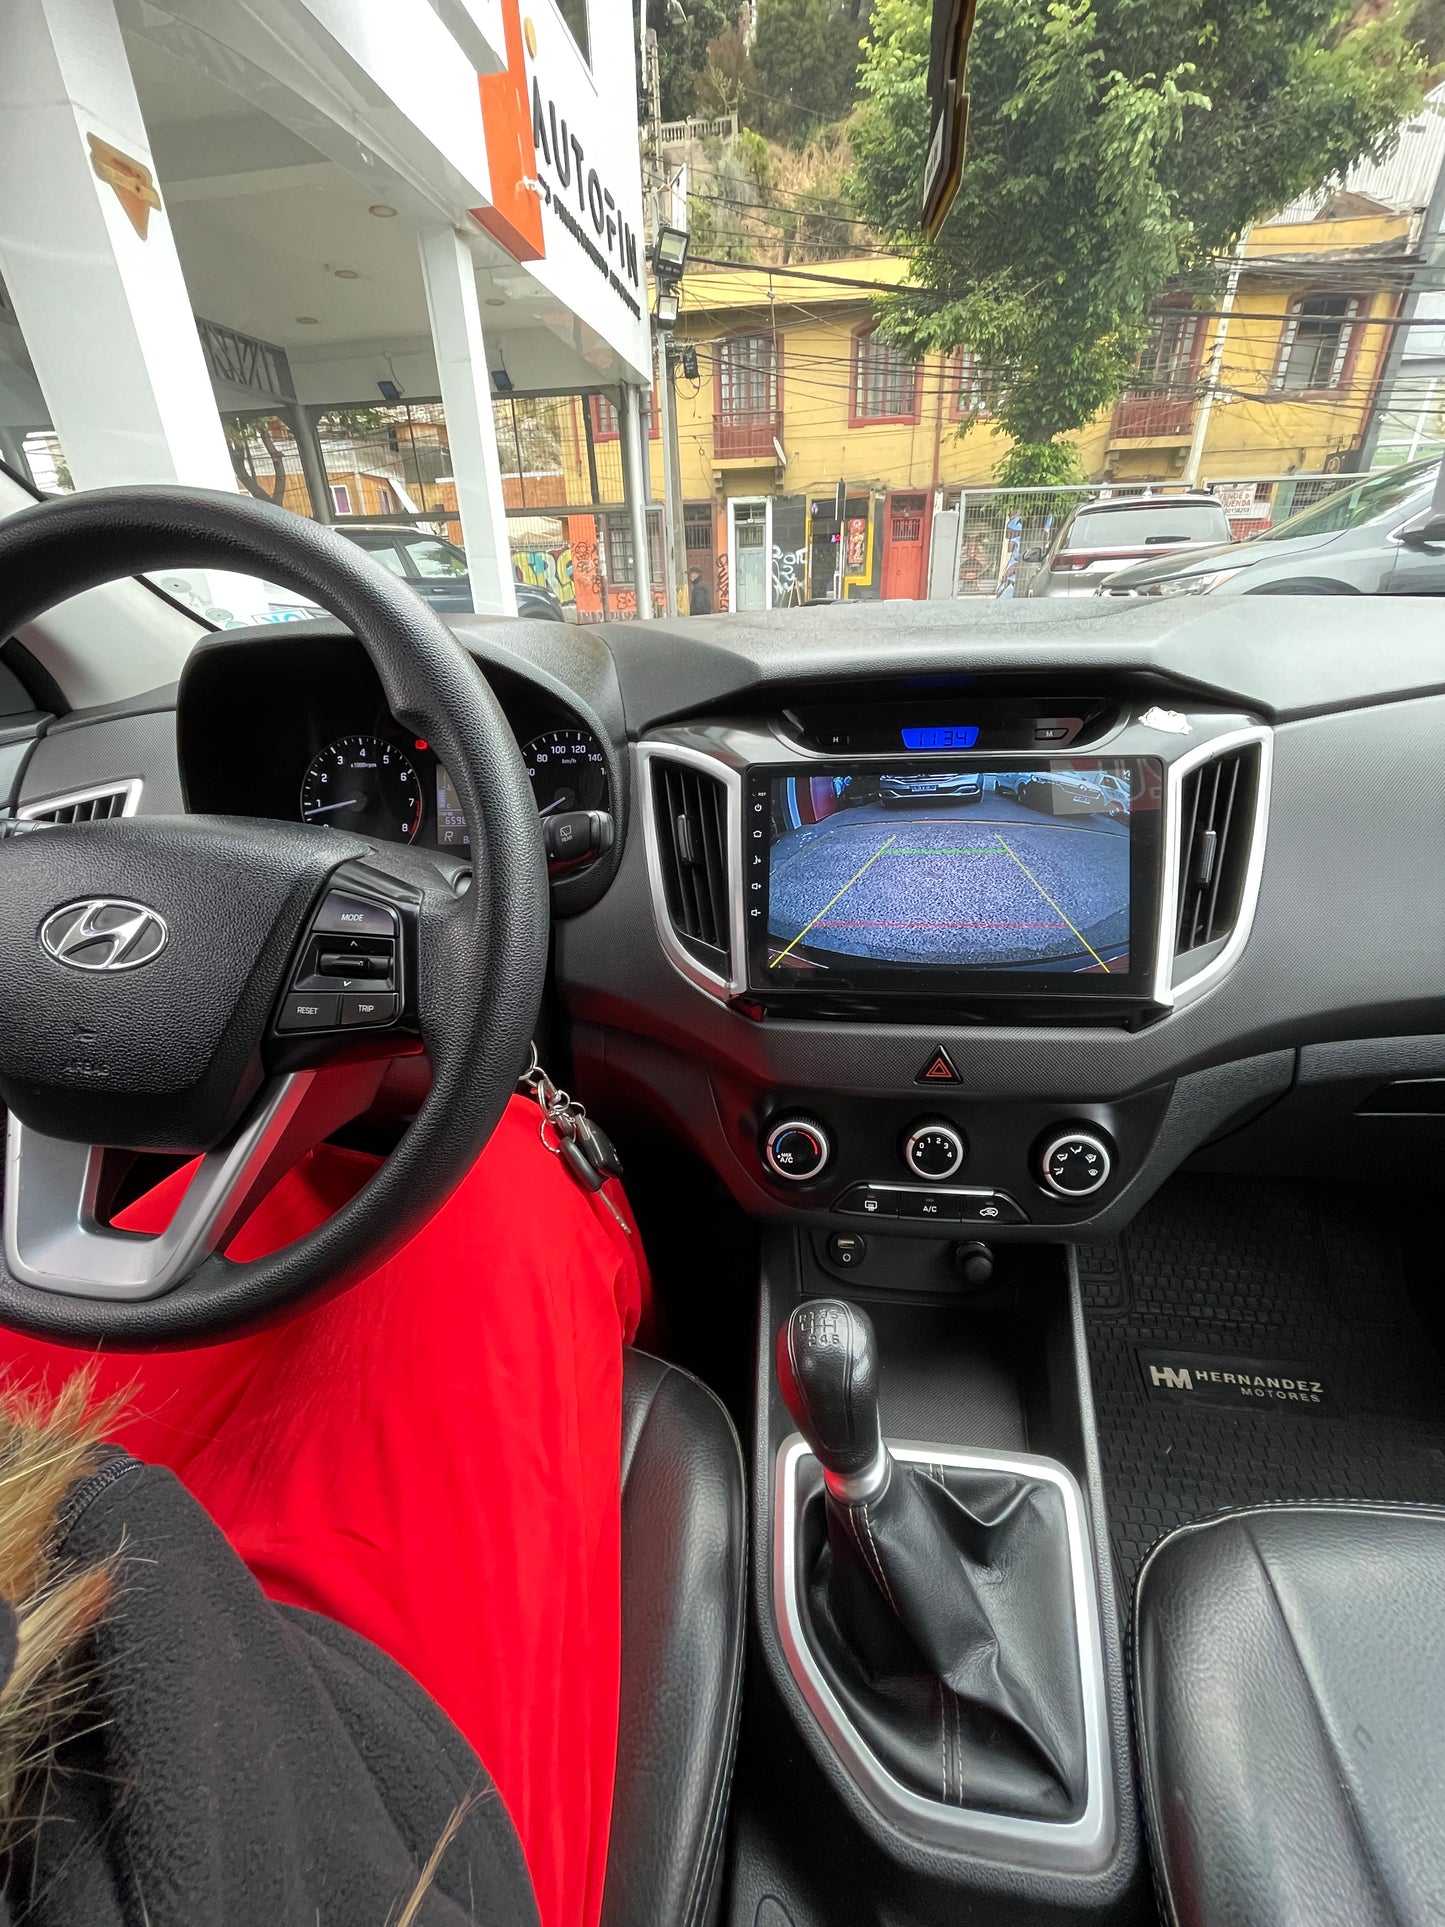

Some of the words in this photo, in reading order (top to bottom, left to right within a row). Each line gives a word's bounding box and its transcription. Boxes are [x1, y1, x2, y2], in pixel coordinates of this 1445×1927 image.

[533, 75, 639, 288] AUTOFIN
[1046, 730, 1053, 738] M
[360, 748, 366, 757] 4
[536, 754, 548, 763] 80
[551, 746, 566, 754] 100
[571, 745, 586, 754] 120
[588, 753, 603, 762] 140
[337, 756, 344, 765] 3
[383, 755, 390, 764] 5
[321, 773, 328, 783] 2
[400, 772, 407, 781] 6
[408, 798, 415, 807] 7
[402, 823, 408, 832] 8
[444, 831, 454, 842] R
[297, 1007, 319, 1015] RESET
[358, 1004, 374, 1012] TRIP
[1149, 1365, 1194, 1390] HM
[1195, 1370, 1324, 1393] HERNANDEZ
[1240, 1387, 1321, 1403] MOTORES
